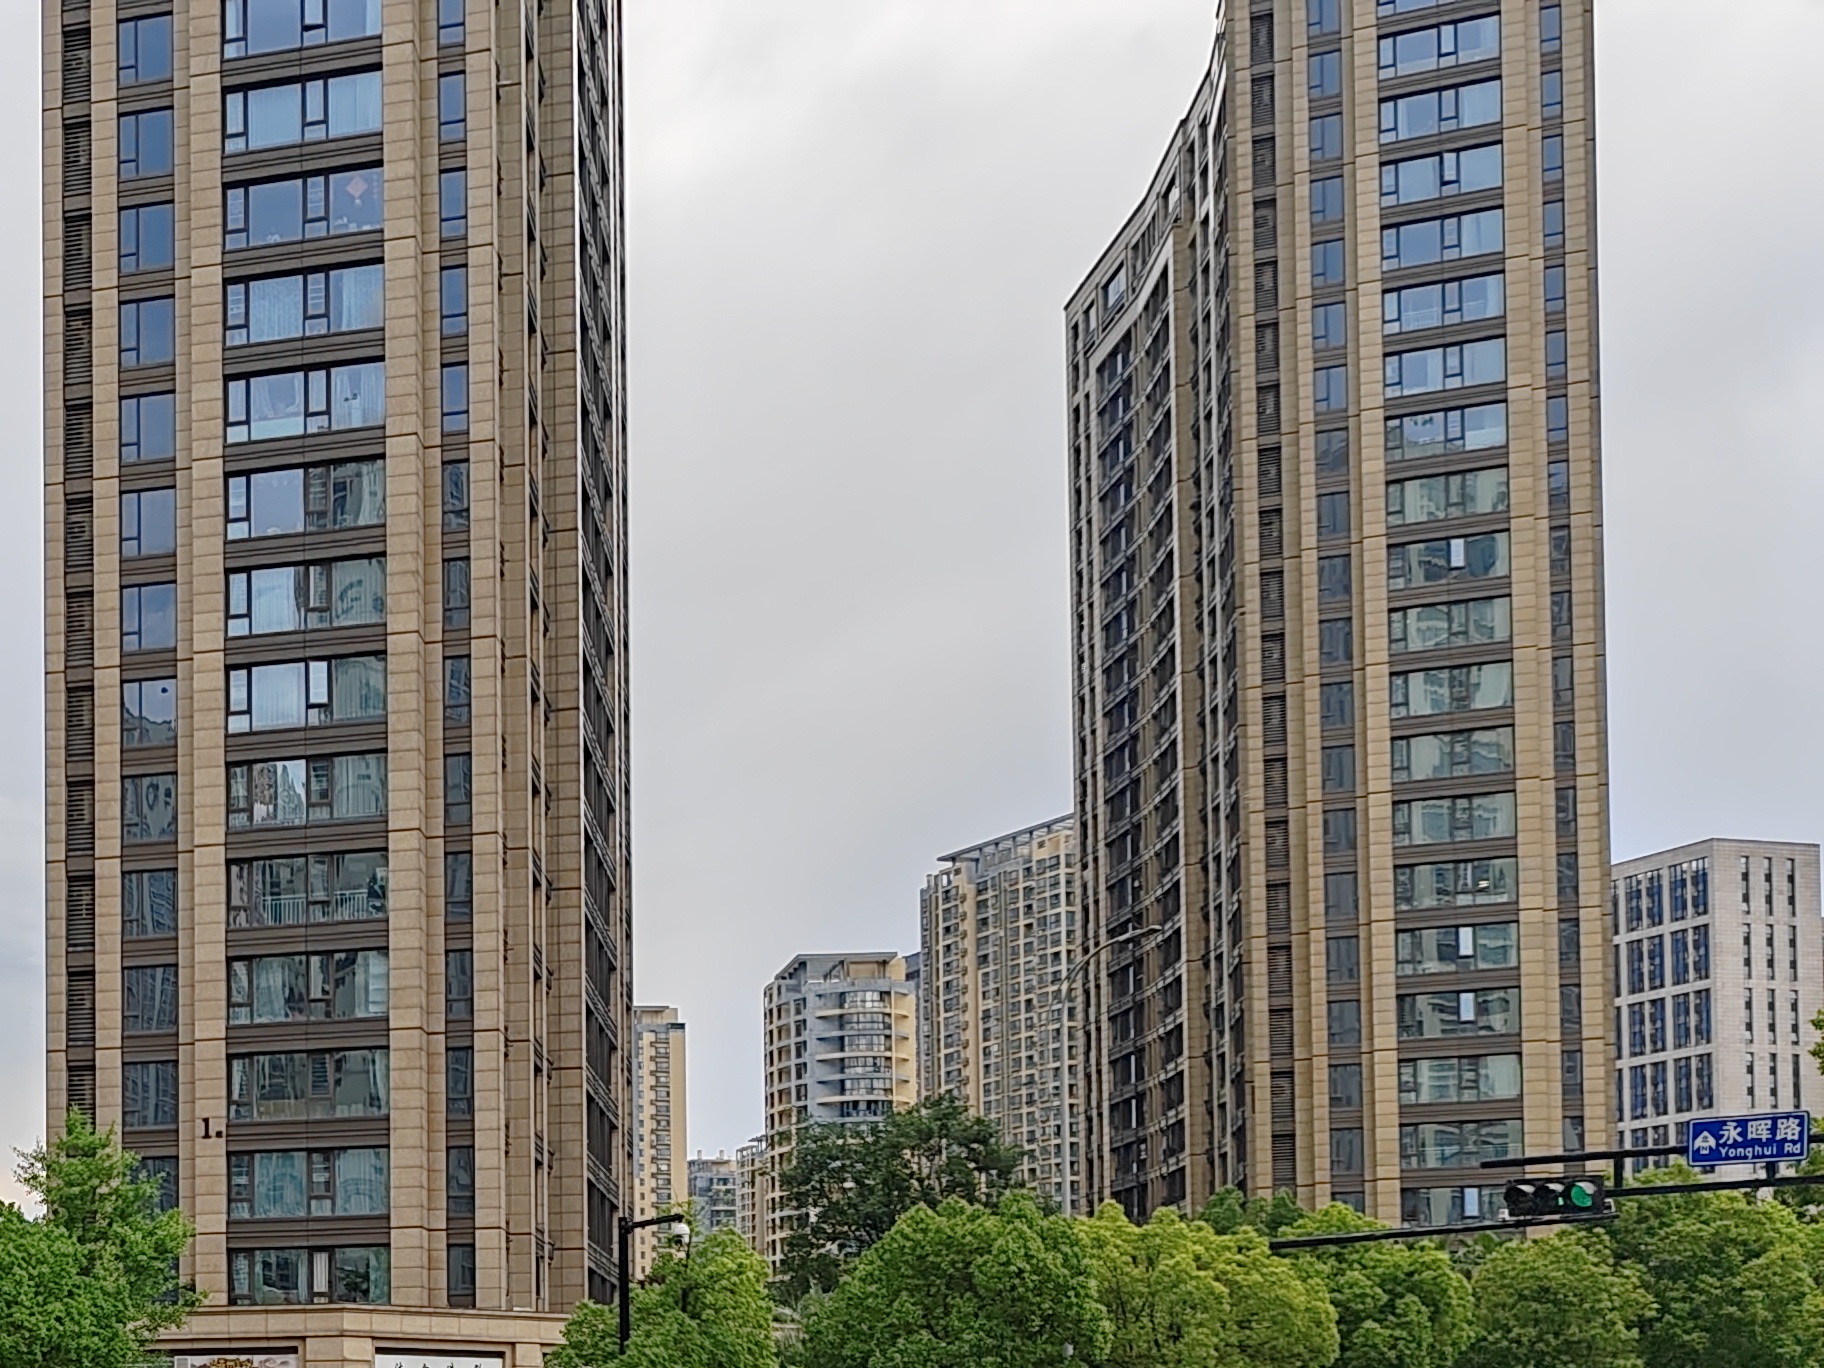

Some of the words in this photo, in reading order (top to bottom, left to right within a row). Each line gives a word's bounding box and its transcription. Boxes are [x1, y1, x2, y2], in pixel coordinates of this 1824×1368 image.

[1718, 1117, 1802, 1146] 永晖路
[1718, 1143, 1777, 1160] Yonghui
[1783, 1142, 1801, 1154] Rd
